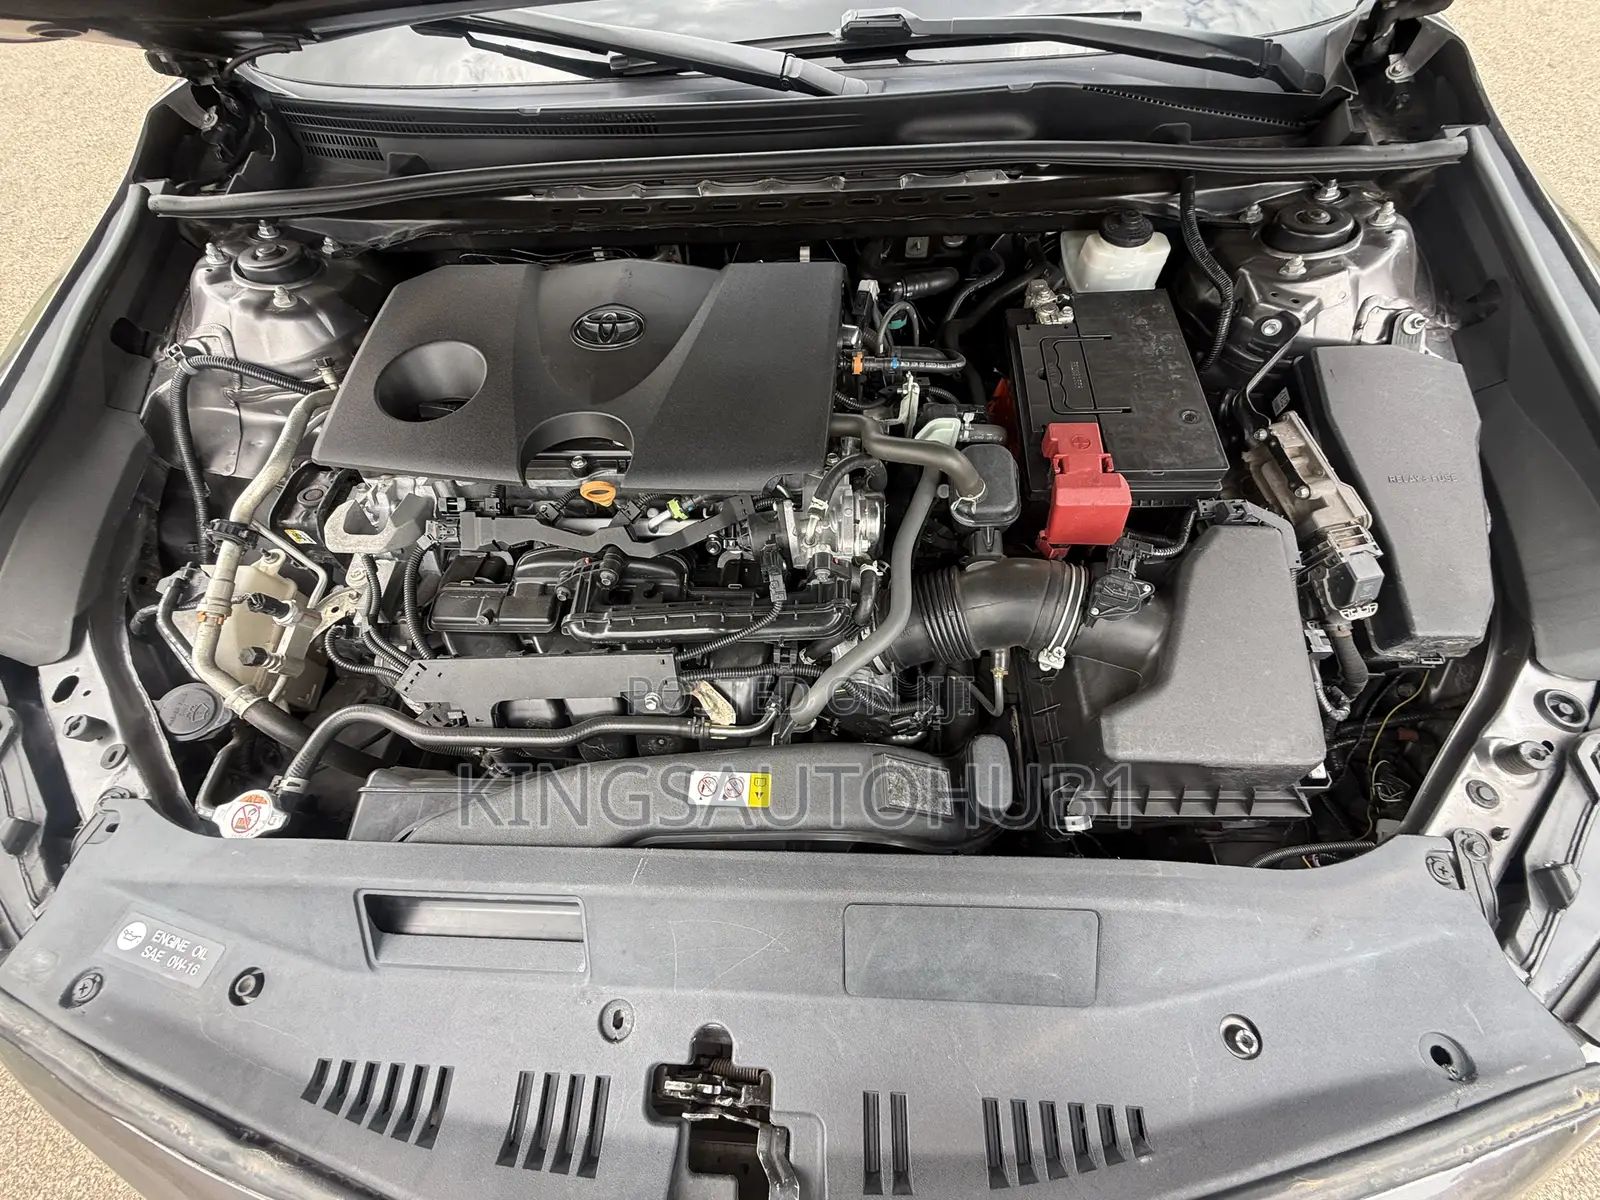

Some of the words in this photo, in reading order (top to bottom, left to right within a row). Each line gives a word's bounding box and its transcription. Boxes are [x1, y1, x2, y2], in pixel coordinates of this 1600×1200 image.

[1387, 475, 1420, 483] RELAY
[1431, 474, 1459, 483] FUSE
[141, 945, 166, 962] SAE
[167, 955, 200, 976] 0W-16
[152, 929, 191, 952] ENGINE
[191, 945, 209, 961] OIL
